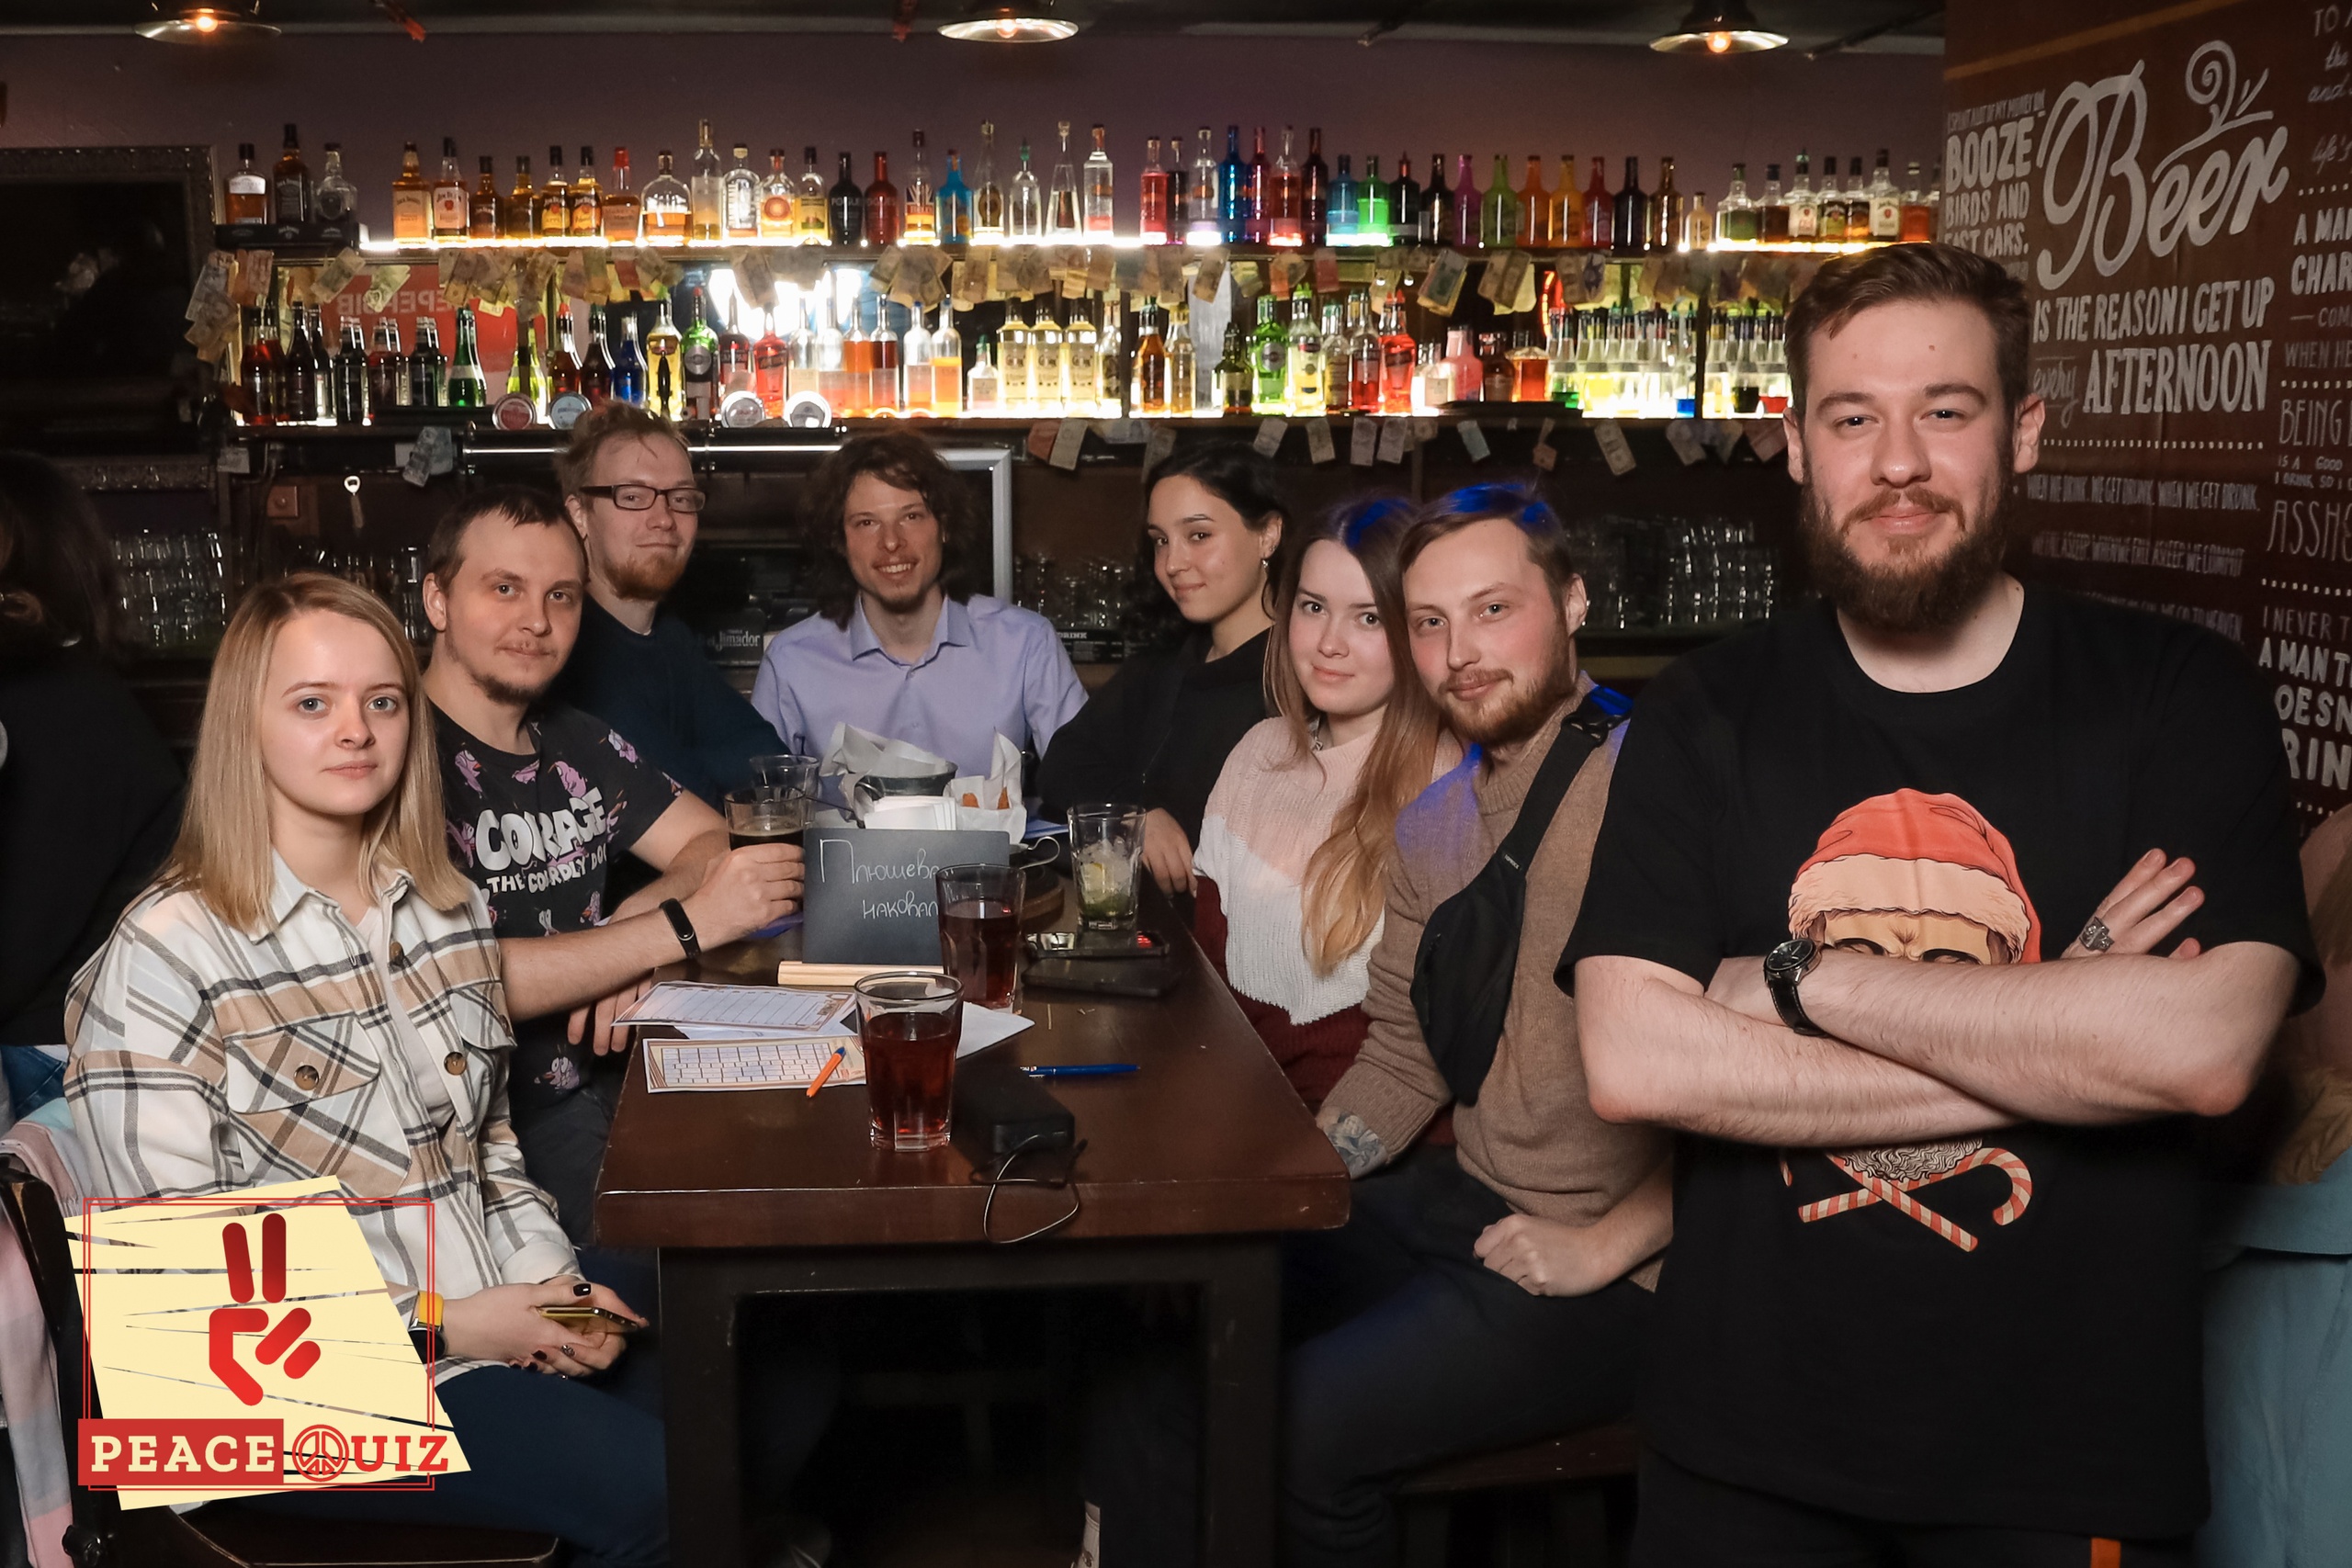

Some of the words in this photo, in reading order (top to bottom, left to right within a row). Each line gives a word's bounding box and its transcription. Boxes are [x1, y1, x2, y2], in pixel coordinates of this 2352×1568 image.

[1945, 117, 2035, 194] BOOZE
[2036, 59, 2290, 290] Beer
[1945, 189, 1992, 229] BIRDS
[1996, 181, 2030, 220] AND
[2293, 213, 2307, 245] A
[1984, 221, 2030, 257] CARS.
[2032, 299, 2051, 344] IS
[2055, 295, 2092, 342] THE
[2093, 286, 2178, 341] REASON
[2178, 287, 2189, 334] I
[2192, 279, 2242, 334] GET
[2242, 276, 2276, 328] UP
[2082, 340, 2273, 414] AFTERNOON
[2279, 399, 2343, 447] BEING
[715, 630, 761, 651] Jimador
[2273, 607, 2332, 641] NEVER
[2258, 637, 2273, 669] A
[2278, 639, 2330, 683] MAN
[2274, 684, 2352, 736] OESN
[486, 873, 526, 893] THE
[527, 854, 586, 893] CORDLY
[591, 843, 606, 871] DO
